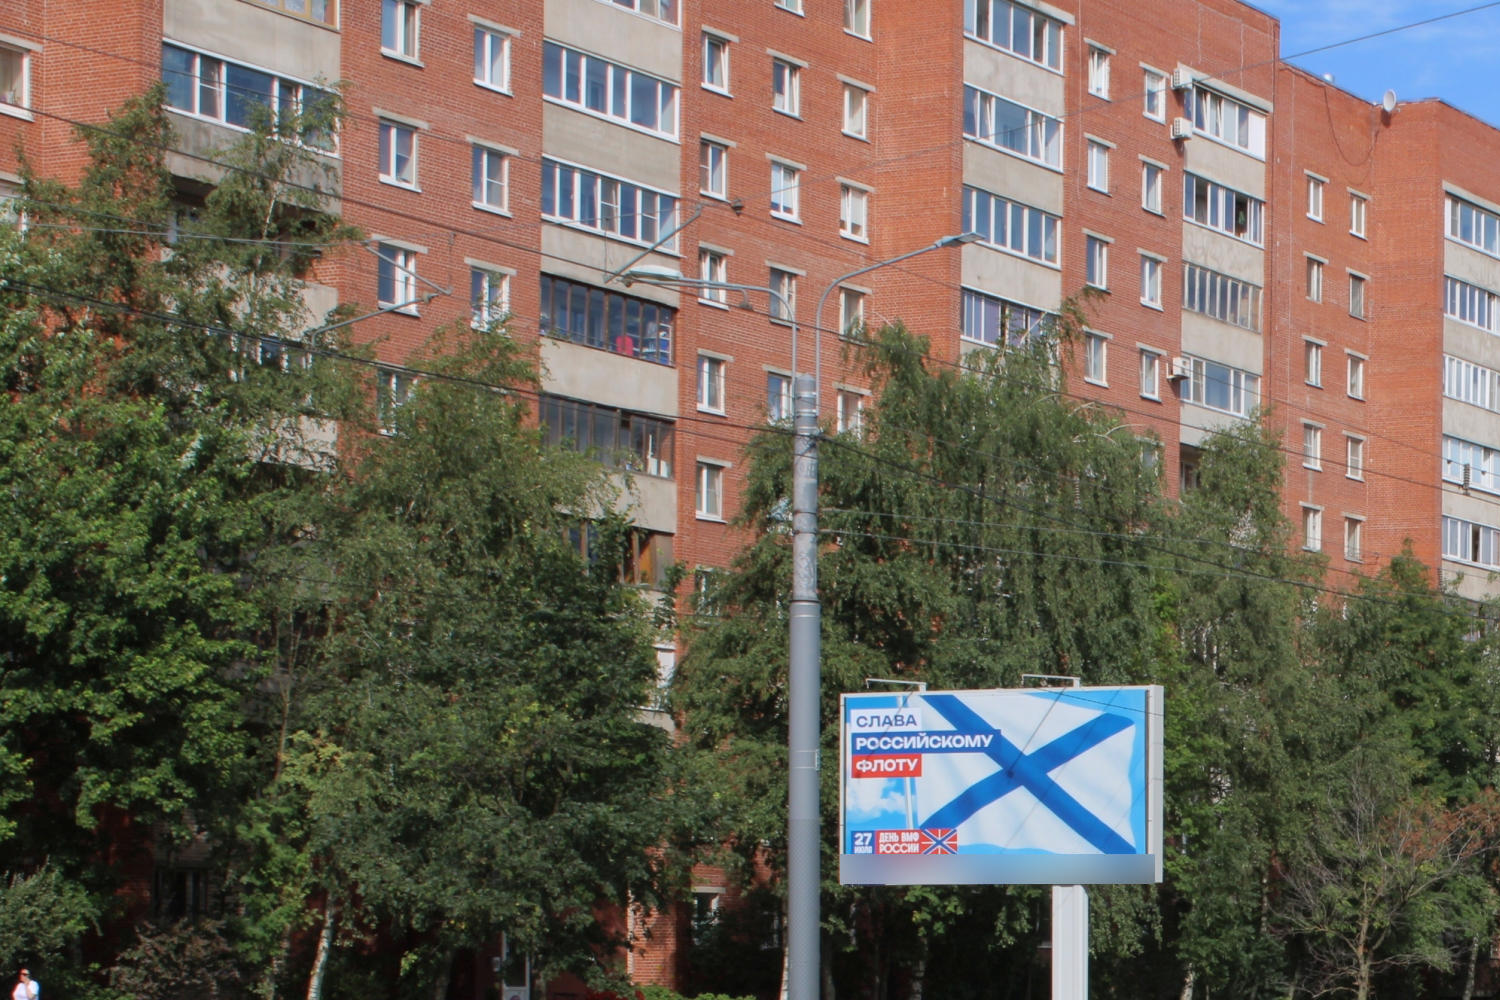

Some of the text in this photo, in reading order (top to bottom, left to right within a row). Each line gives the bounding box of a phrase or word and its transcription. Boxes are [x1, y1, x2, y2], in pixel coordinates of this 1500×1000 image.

[856, 714, 918, 728] СЛАВА
[855, 732, 994, 750] РОССИЙСКОМУ
[856, 758, 919, 773] ФЛОТУ
[854, 832, 872, 846] 27
[879, 831, 919, 843] ДЕНЬ ВМФ
[879, 843, 919, 854] РОССИИ
